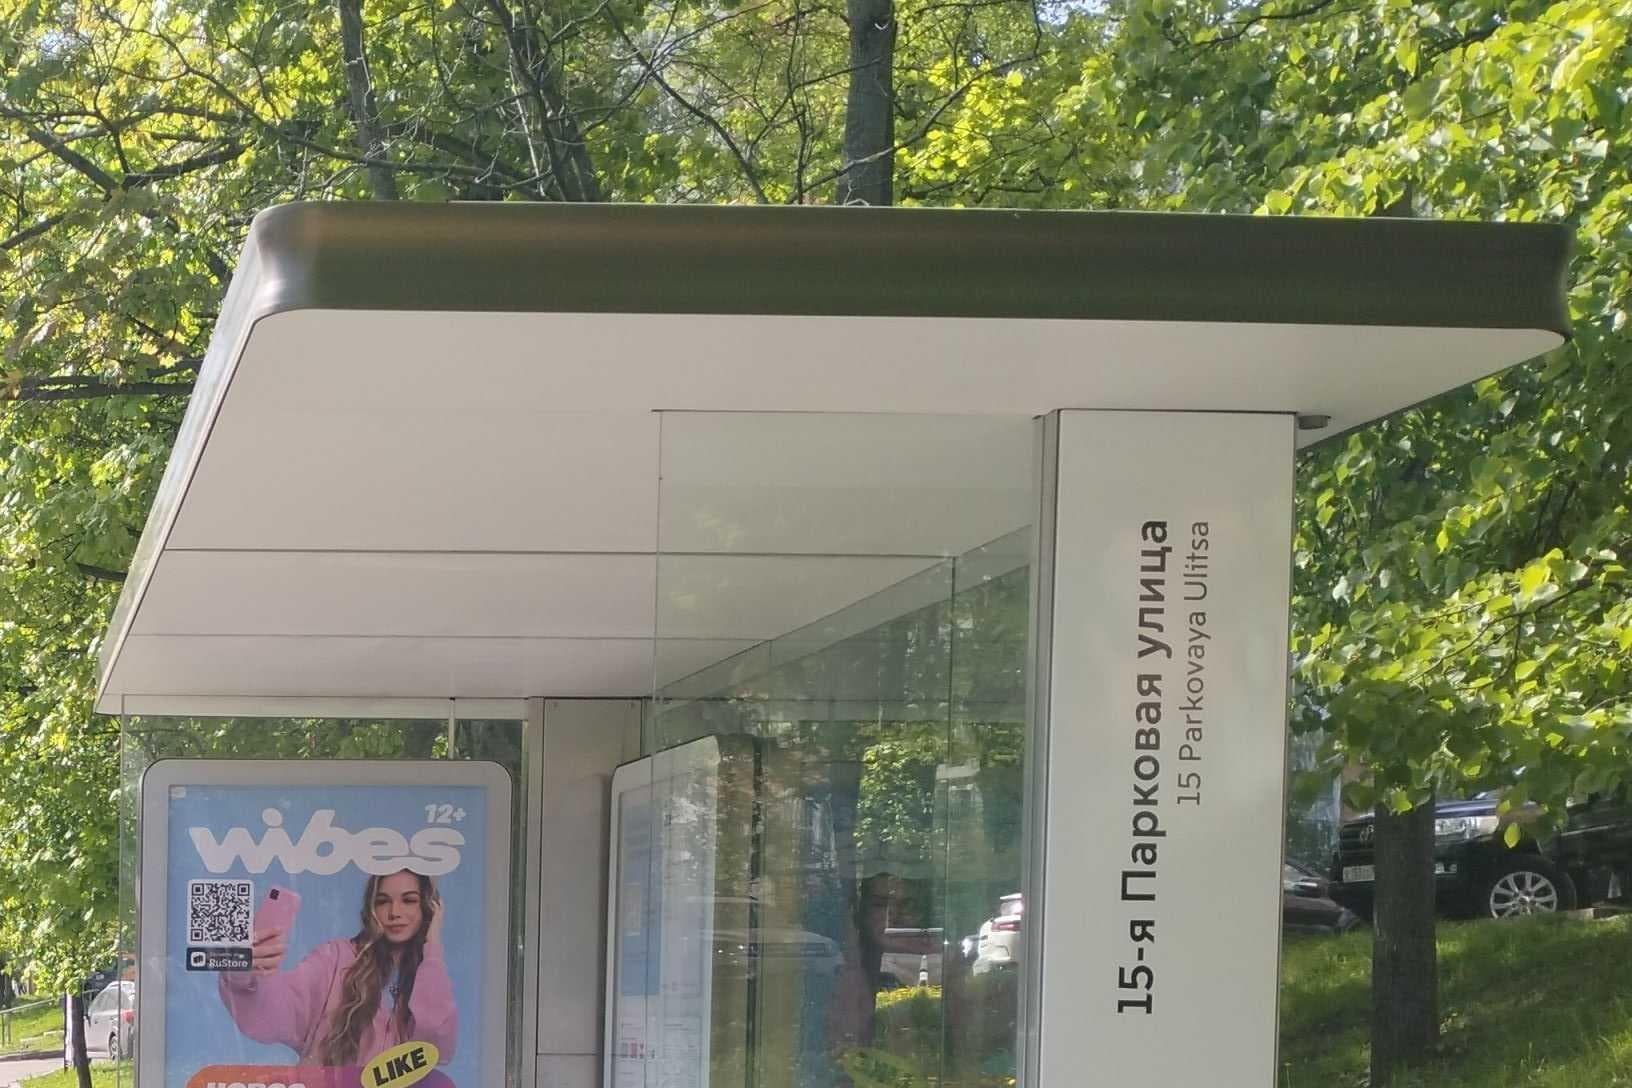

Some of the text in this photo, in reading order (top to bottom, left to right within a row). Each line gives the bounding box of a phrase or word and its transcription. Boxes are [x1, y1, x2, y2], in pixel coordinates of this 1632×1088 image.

[1176, 520, 1212, 806] 15 Parkovaya Ulitsa
[1117, 519, 1173, 1015] 15-я Парковая улица
[424, 803, 467, 824] 12+
[188, 807, 467, 877] wibes
[208, 958, 249, 969] RuStore
[372, 1046, 426, 1086] LIKE
